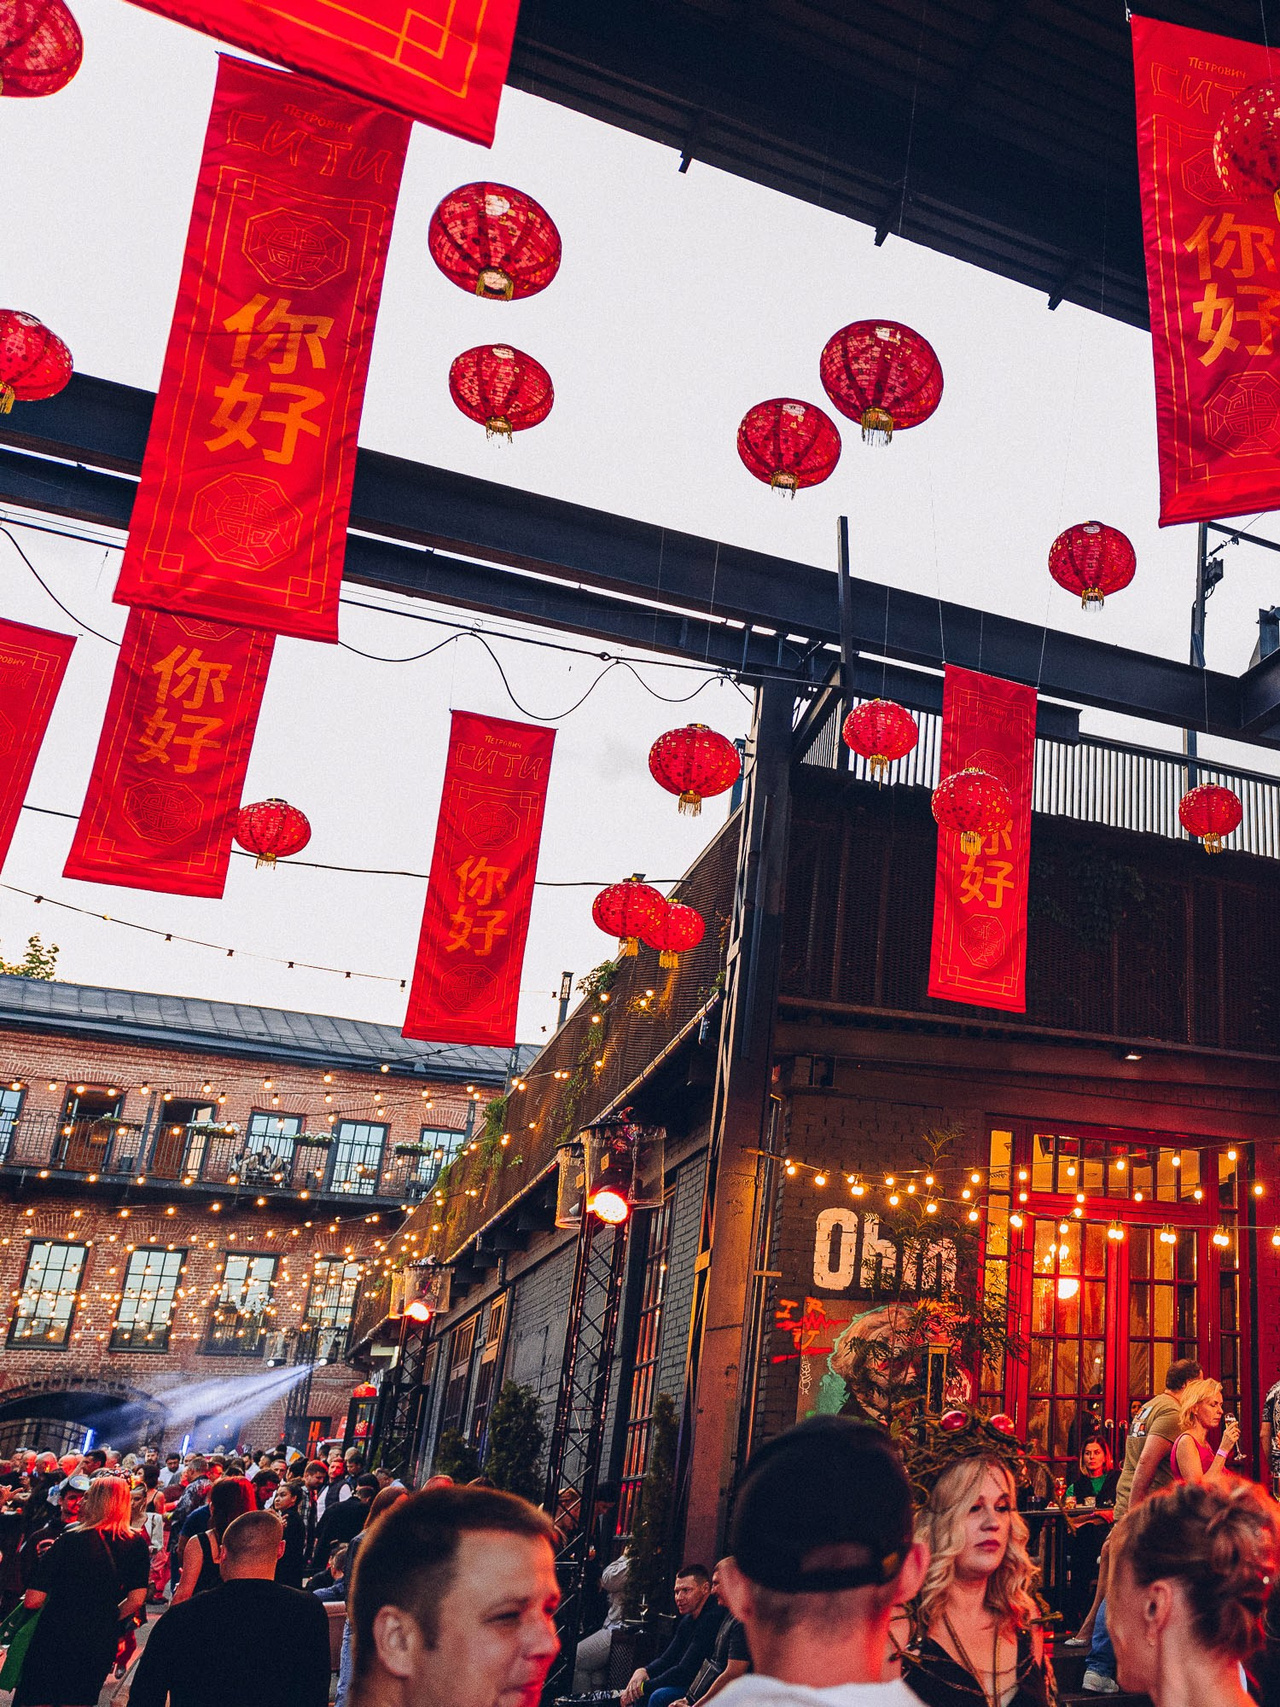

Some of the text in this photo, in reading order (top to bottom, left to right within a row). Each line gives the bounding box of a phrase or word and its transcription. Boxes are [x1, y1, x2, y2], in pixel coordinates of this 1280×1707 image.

[1188, 56, 1247, 79] ПЕТРОВИЧ
[226, 109, 393, 185] СИТИ
[282, 103, 354, 133] ПЕТРОВИЧ
[202, 293, 335, 466] 你好
[134, 644, 234, 774] 你好
[455, 742, 544, 781] СИТИ
[445, 854, 511, 957] 你好
[813, 1207, 957, 1291] Ohm
